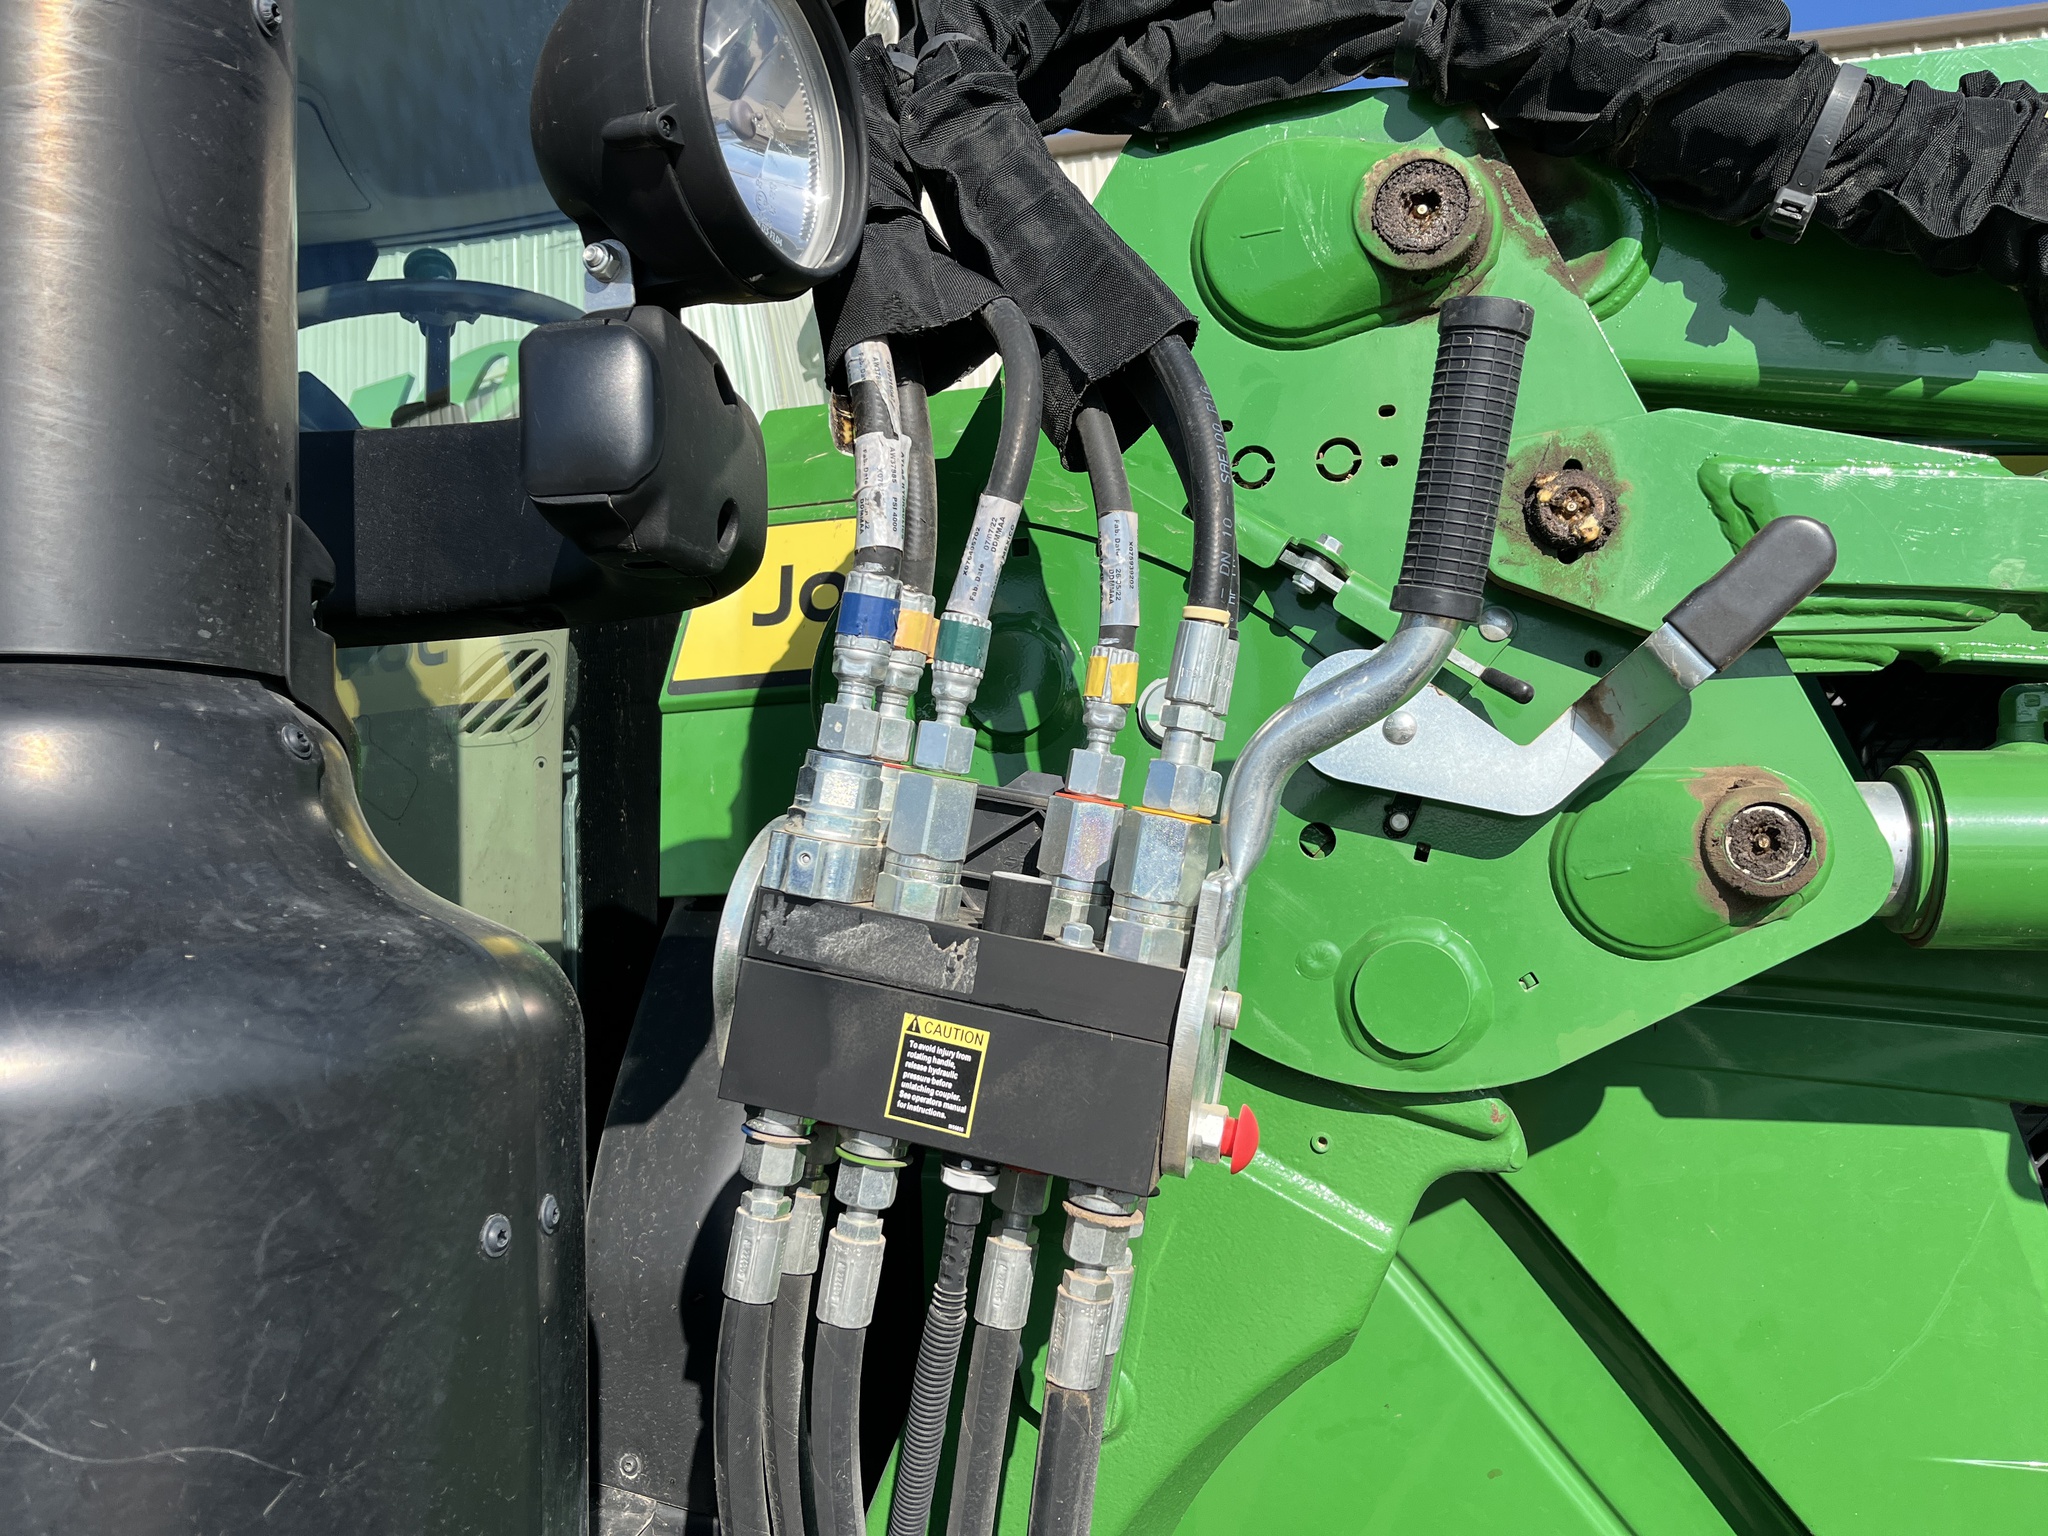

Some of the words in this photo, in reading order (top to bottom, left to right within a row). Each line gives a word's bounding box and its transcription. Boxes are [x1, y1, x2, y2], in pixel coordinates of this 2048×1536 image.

[1212, 424, 1231, 482] SAE100
[990, 516, 1007, 553] DDMMAA
[1221, 517, 1234, 538] 10
[1219, 551, 1232, 576] DN
[969, 584, 979, 601] Fab.
[976, 564, 984, 582] Date
[1107, 569, 1116, 605] DDMMAA
[924, 1021, 984, 1046] CAUTION
[907, 1052, 932, 1064] rotating
[932, 1057, 956, 1069] handle,
[909, 1040, 918, 1049] To
[918, 1043, 936, 1053] avoid
[937, 1047, 955, 1059] injury
[956, 1052, 971, 1062] from
[902, 1072, 930, 1085] pressure
[932, 1077, 952, 1088] before
[905, 1062, 927, 1072] release
[928, 1066, 958, 1079] hydraulic
[899, 1090, 912, 1100] See
[912, 1094, 942, 1108] operators
[943, 1104, 967, 1113] manual
[901, 1082, 934, 1096] unlatching
[935, 1091, 961, 1101] coupler.
[897, 1100, 905, 1109] for
[907, 1104, 946, 1119] instructions.
